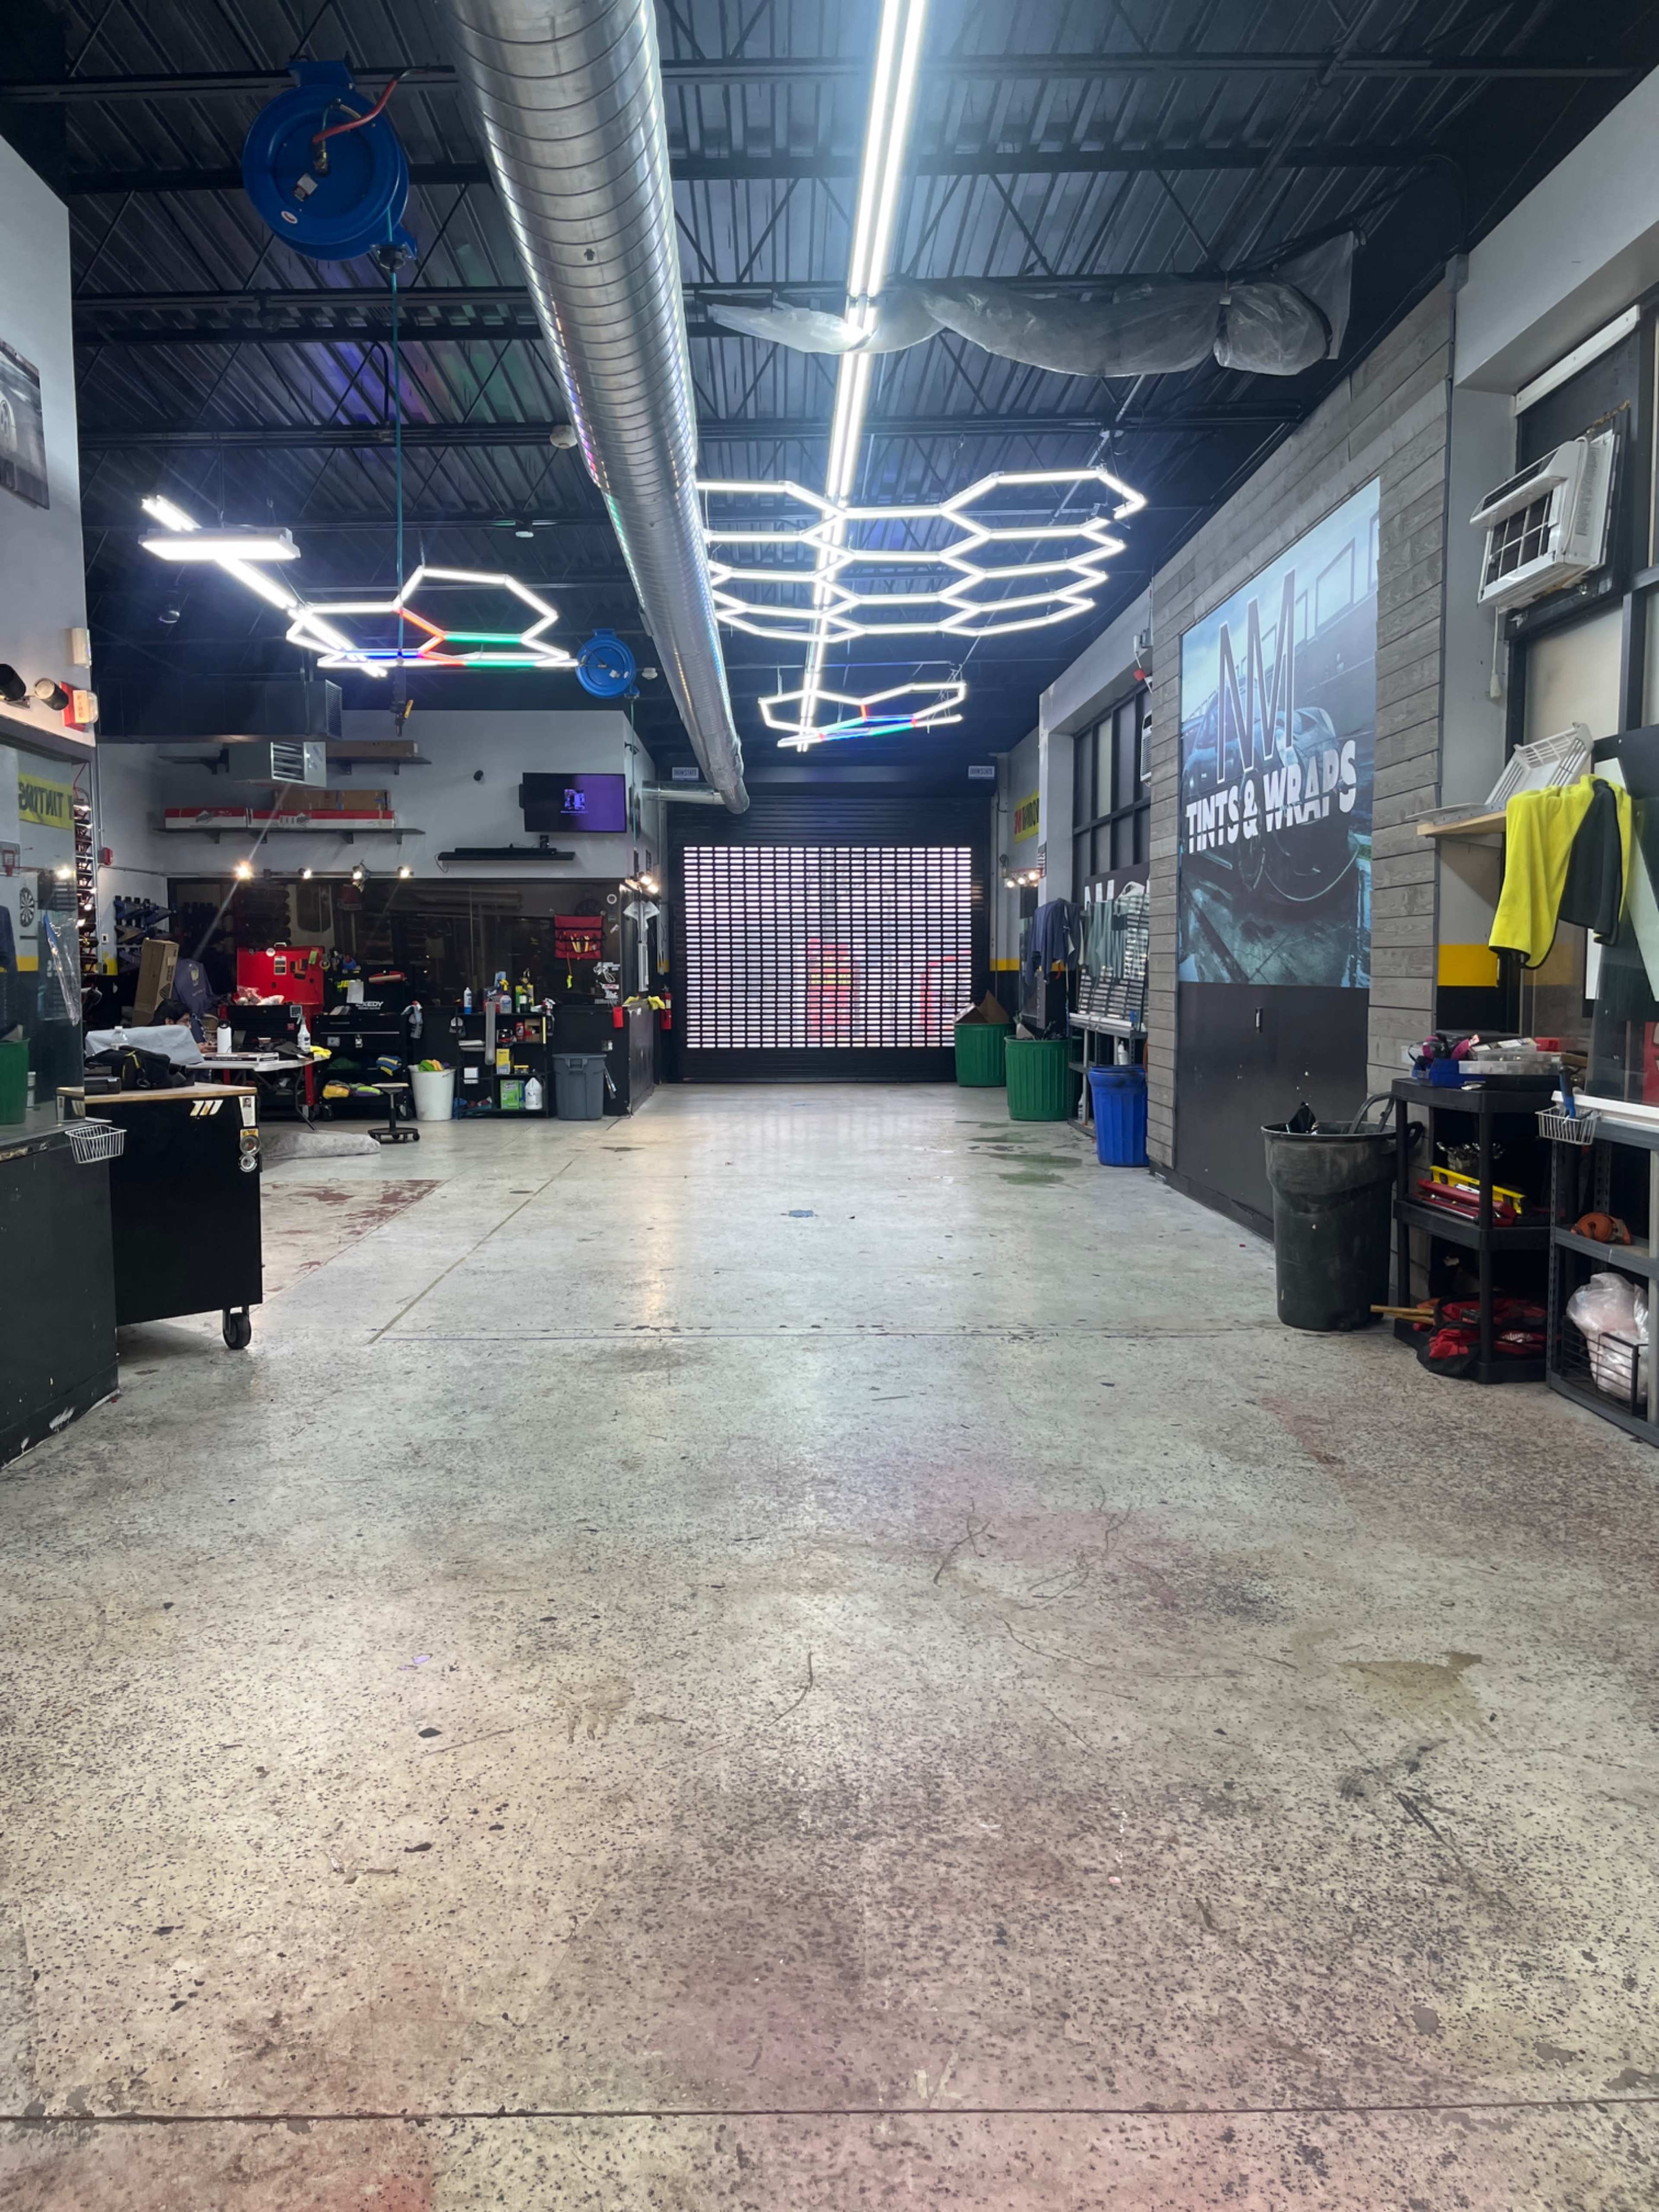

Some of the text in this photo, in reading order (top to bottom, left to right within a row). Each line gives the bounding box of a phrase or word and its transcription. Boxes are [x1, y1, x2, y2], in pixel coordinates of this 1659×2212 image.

[1185, 740, 1357, 854] TINTS & WRAPS
